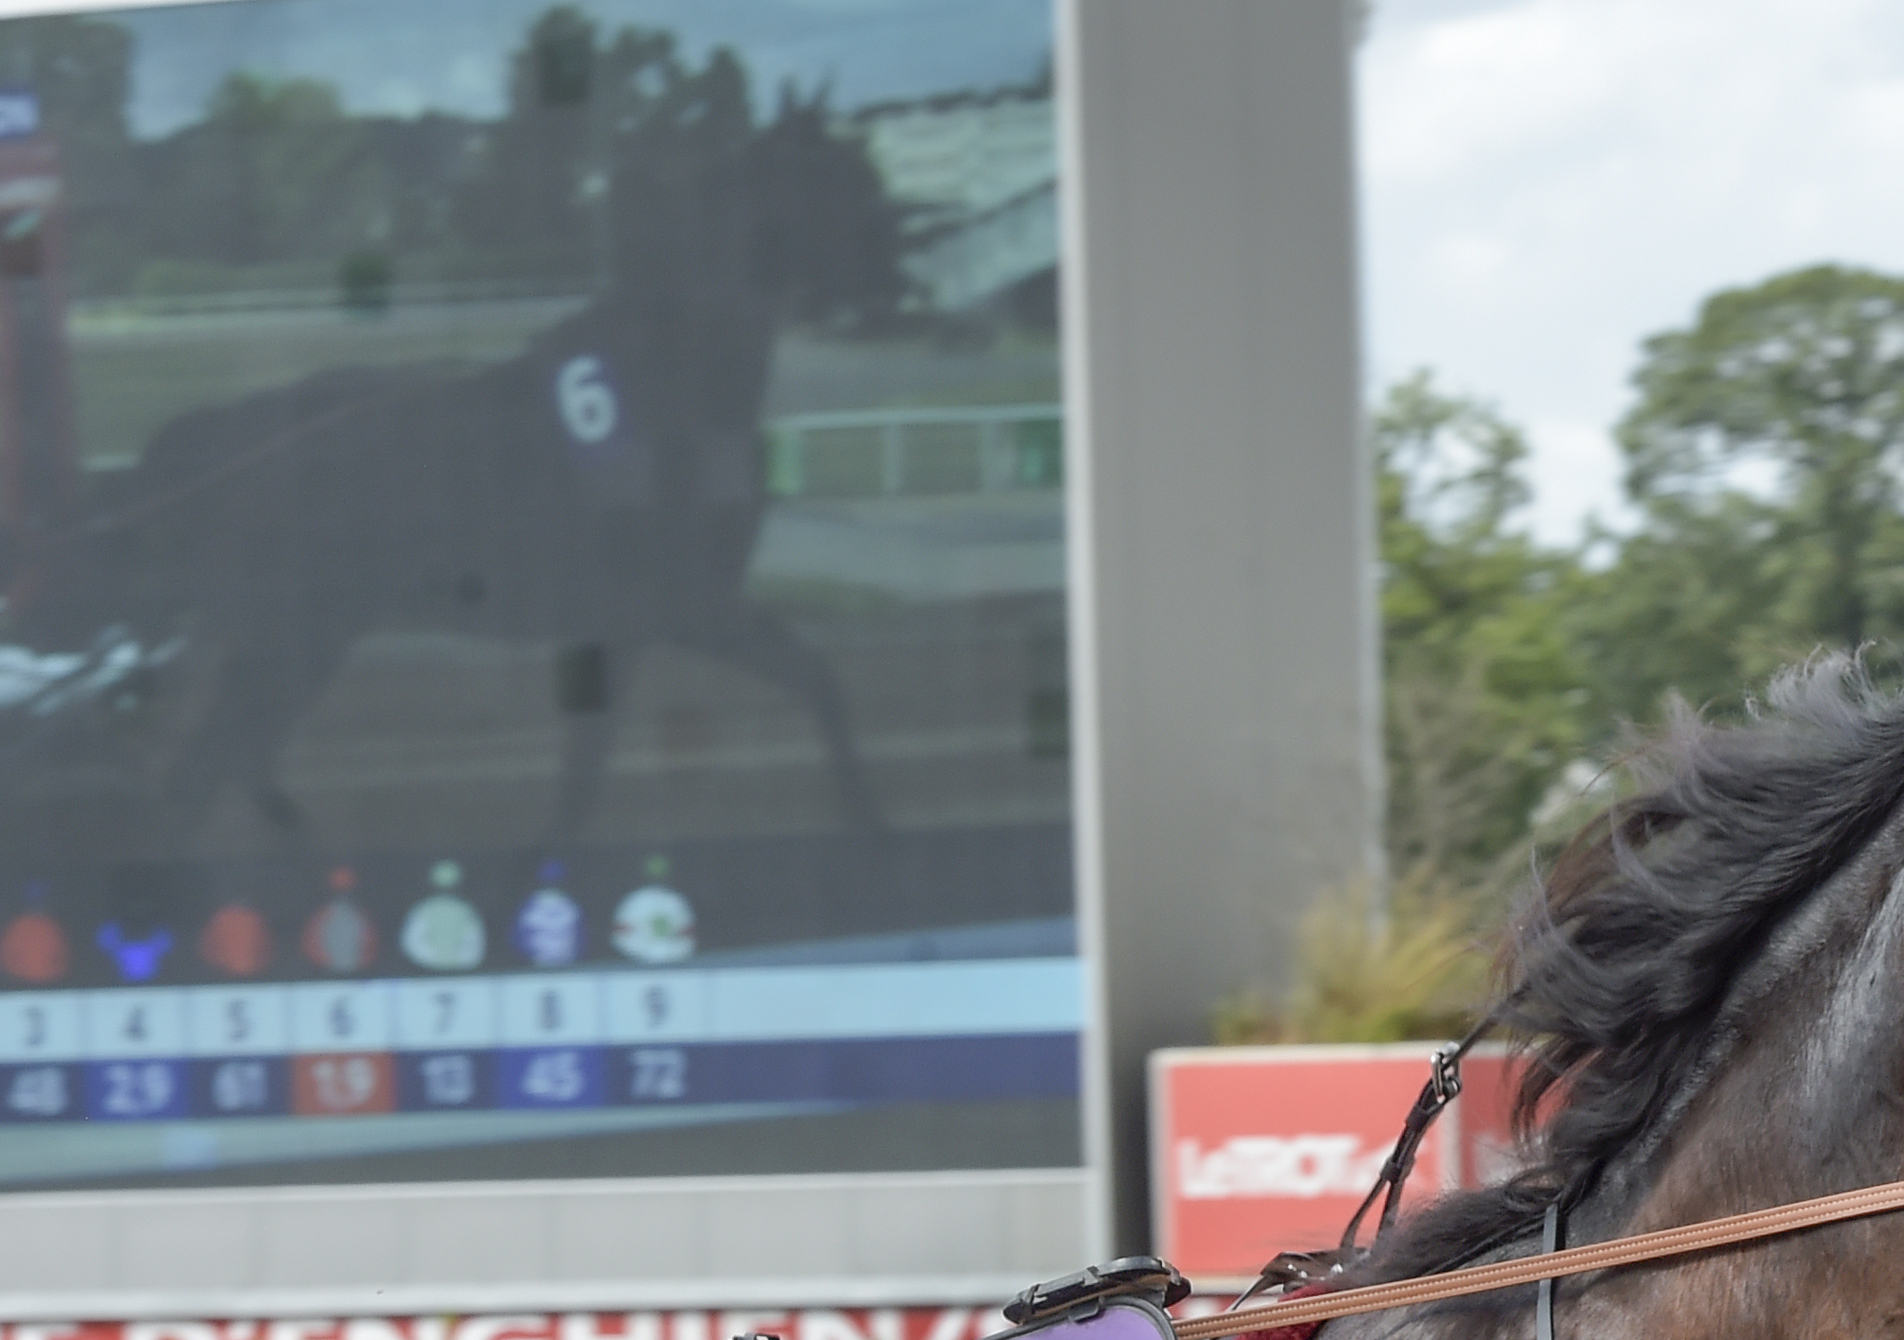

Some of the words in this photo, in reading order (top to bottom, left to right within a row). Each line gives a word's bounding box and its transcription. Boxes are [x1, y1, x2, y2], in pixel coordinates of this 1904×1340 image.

[557, 355, 617, 442] 6
[22, 1003, 46, 1045] 3
[122, 1003, 147, 1041] 4
[226, 999, 252, 1041] 5
[330, 996, 355, 1038] 6
[433, 992, 456, 1034] 7
[537, 988, 563, 1031] 8
[643, 984, 669, 1028] 9
